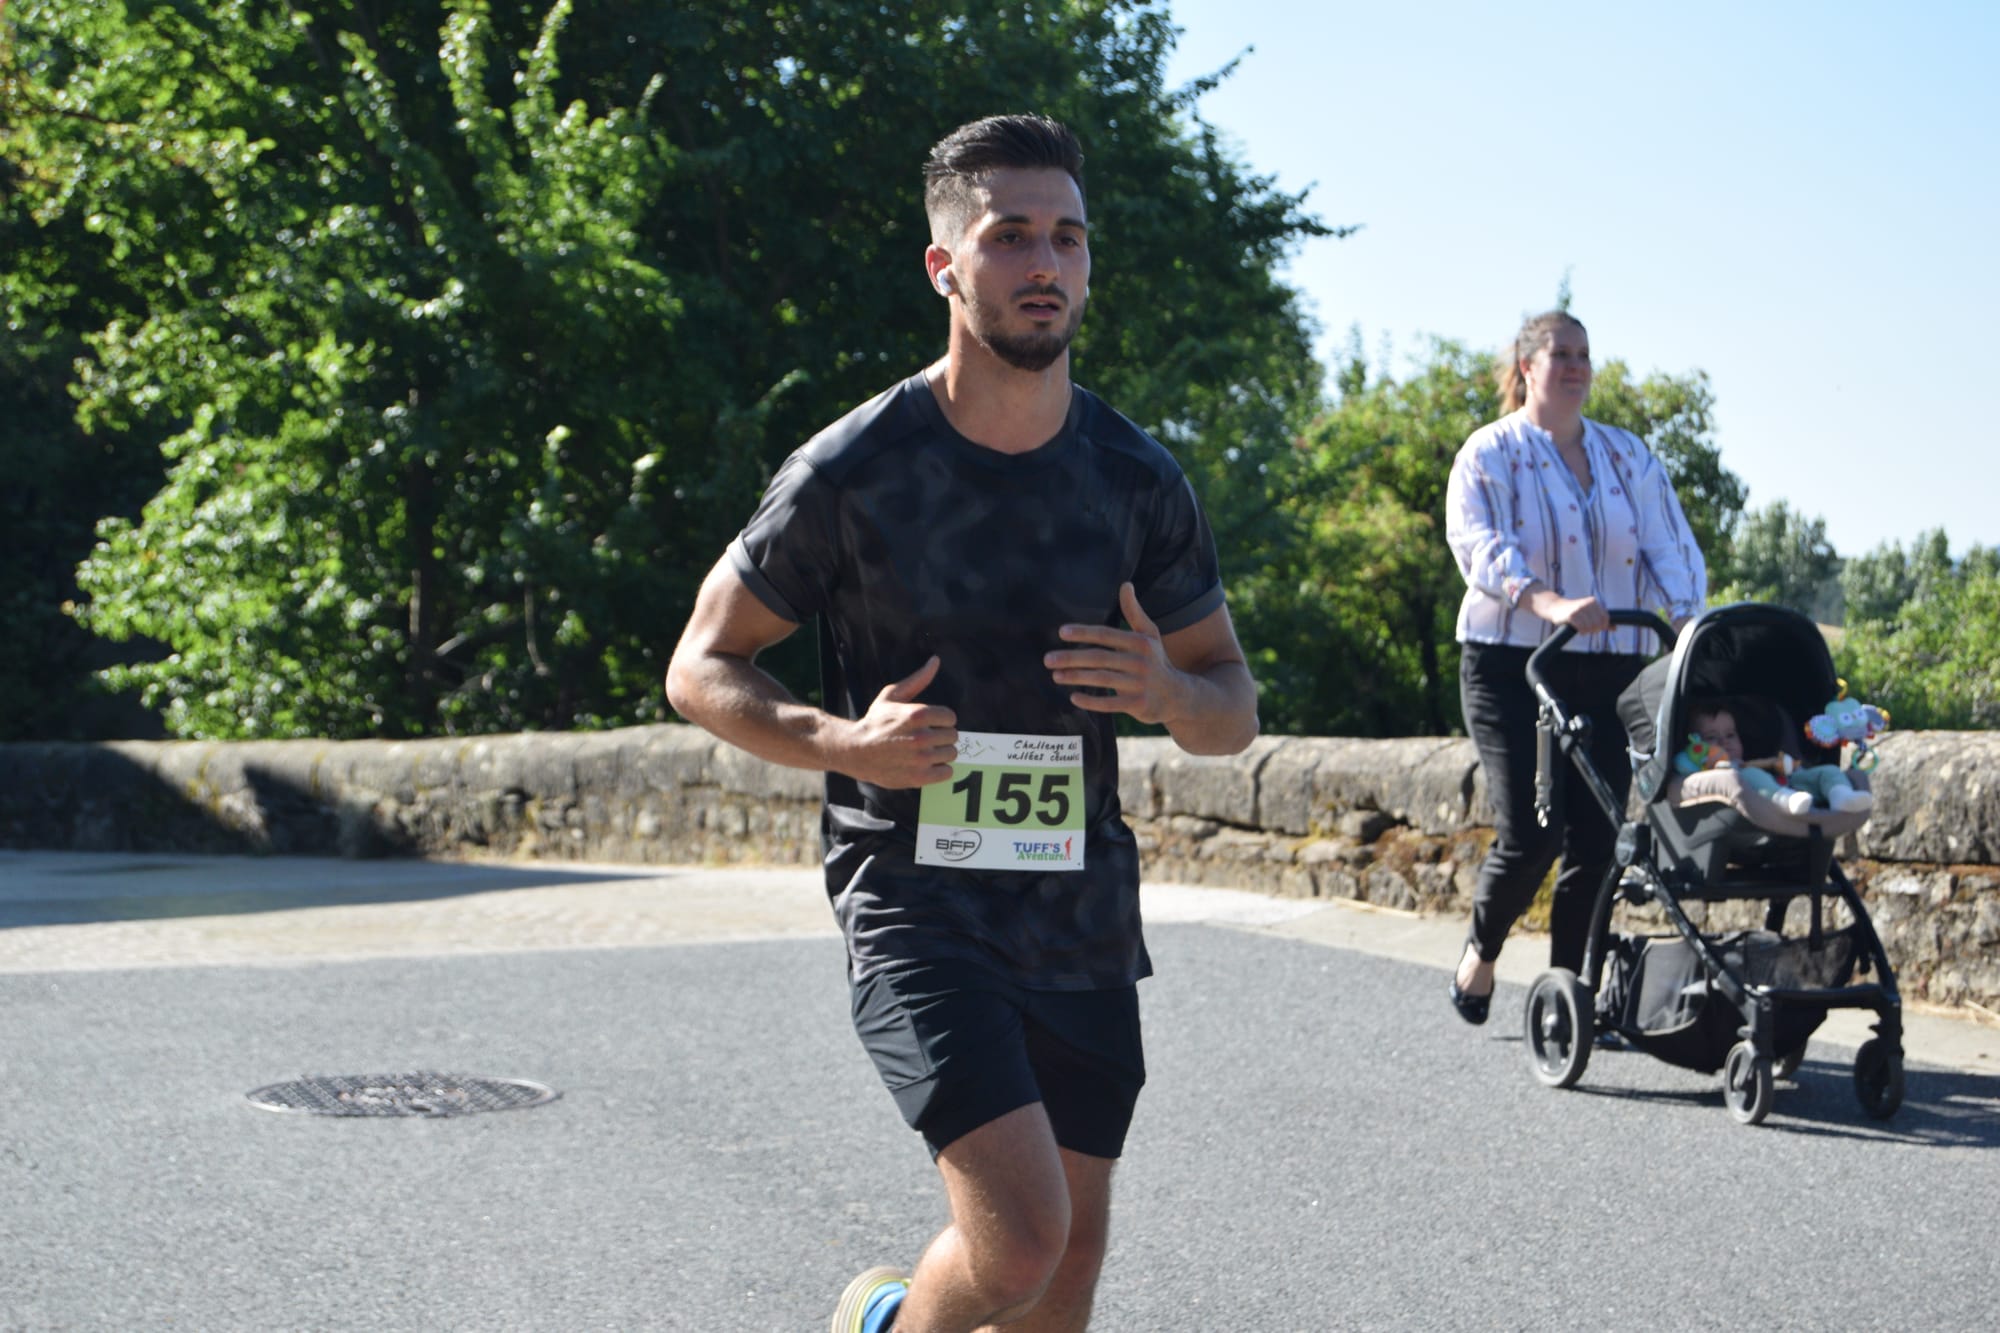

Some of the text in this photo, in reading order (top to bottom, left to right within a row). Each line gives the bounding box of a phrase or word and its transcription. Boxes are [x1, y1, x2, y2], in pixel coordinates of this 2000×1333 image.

[1014, 740, 1064, 753] Challenge
[1007, 751, 1044, 761] vallées
[952, 770, 1070, 826] 155
[935, 838, 977, 852] BFP
[1013, 842, 1061, 854] TUFF'S
